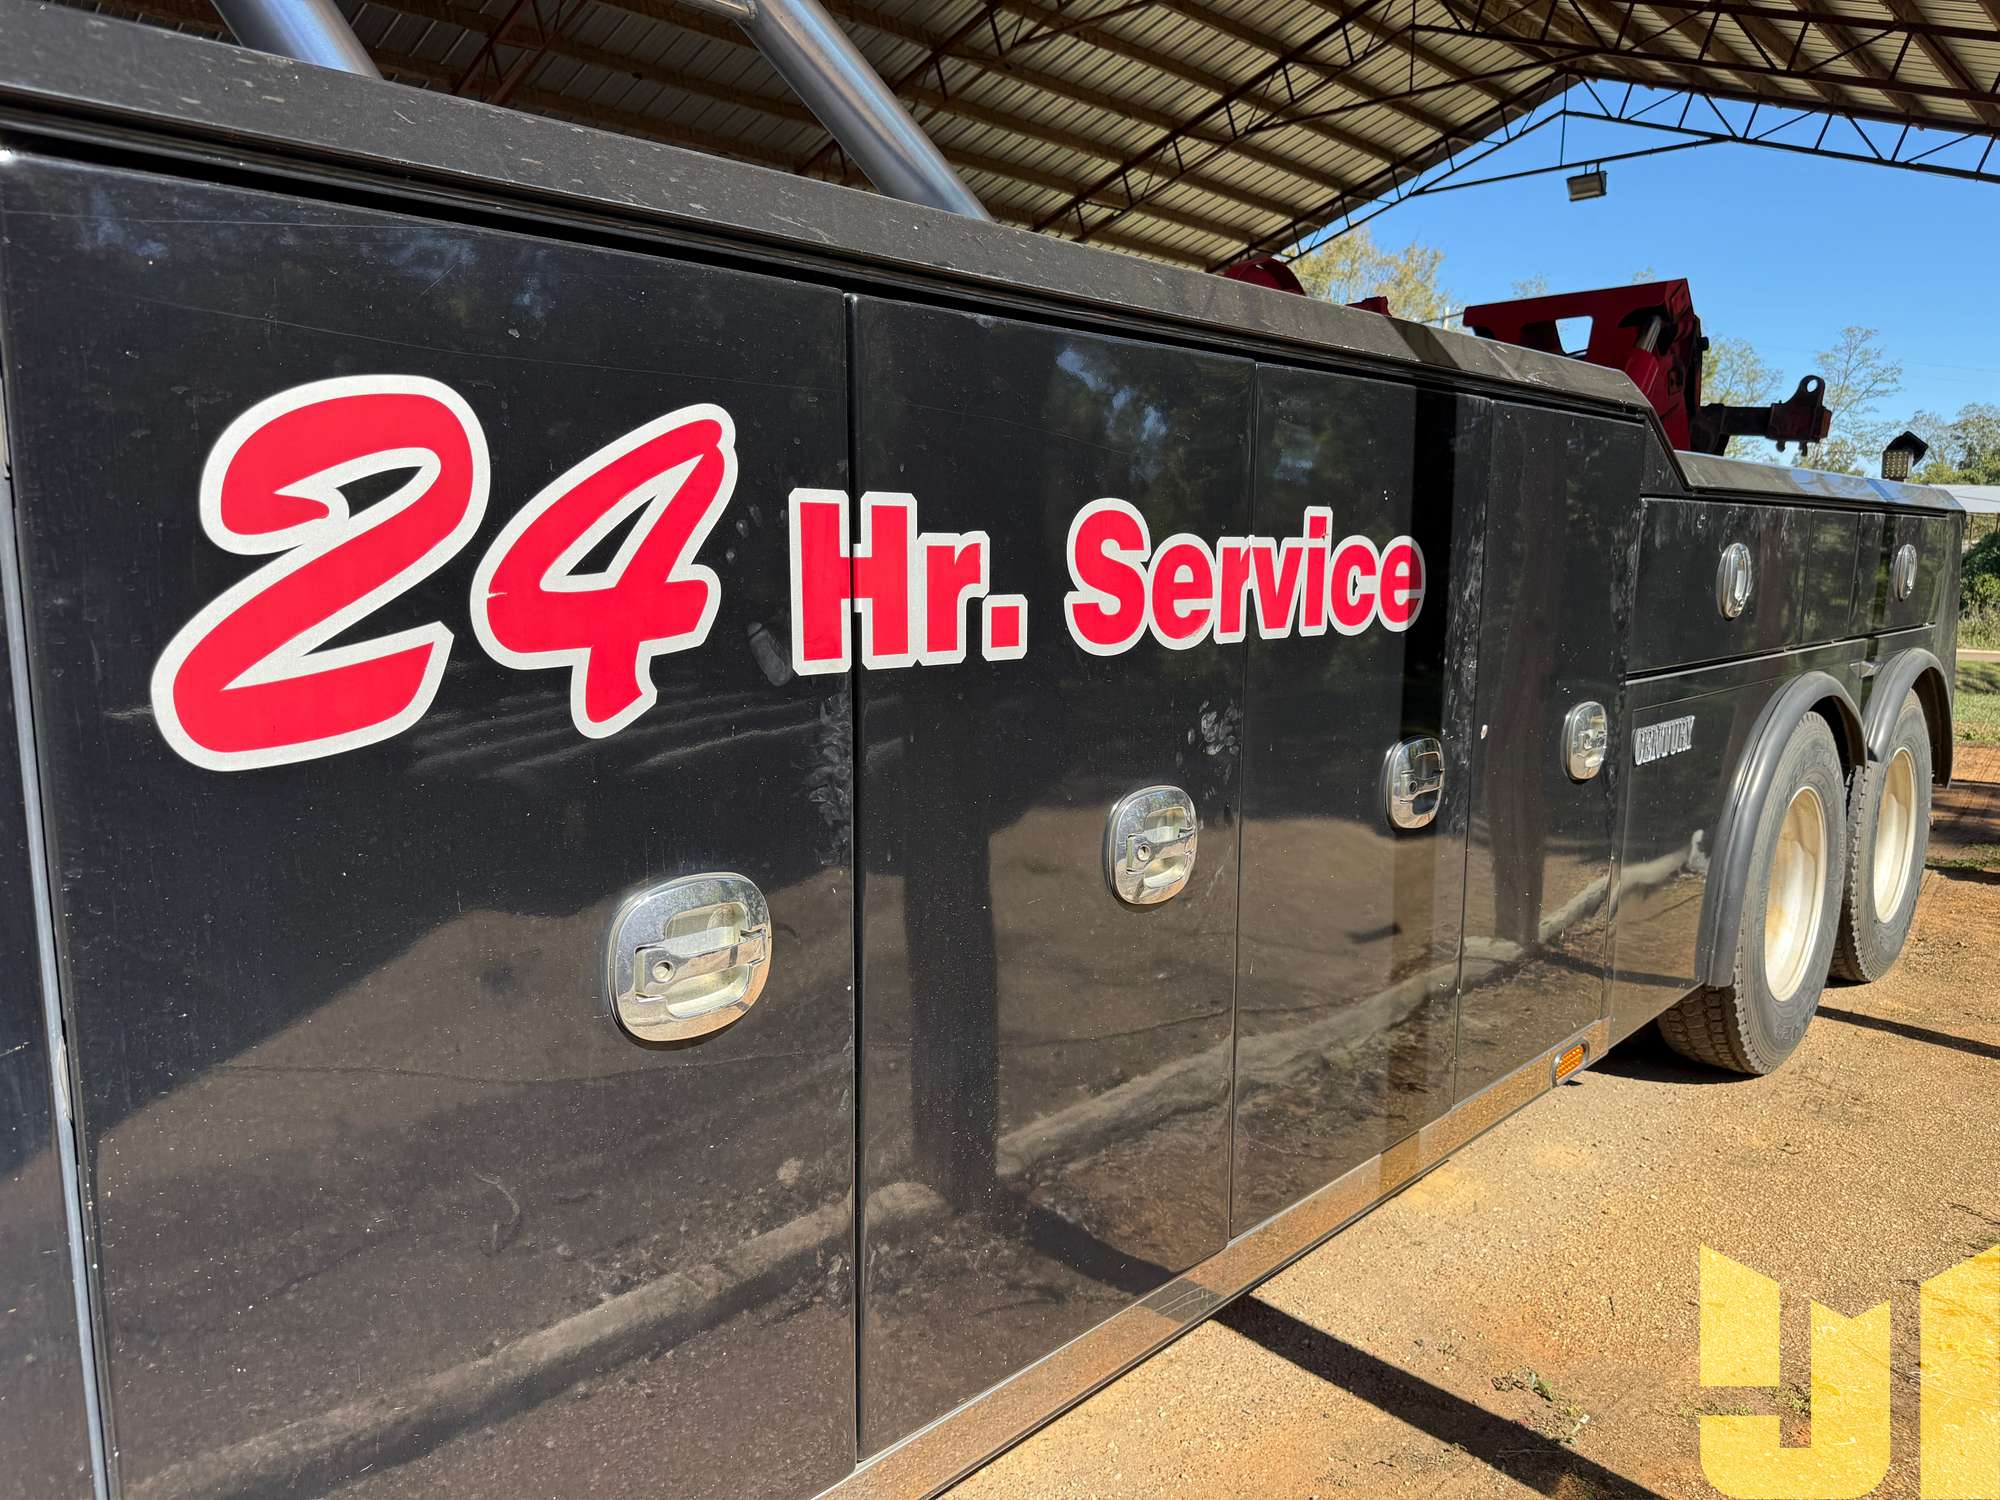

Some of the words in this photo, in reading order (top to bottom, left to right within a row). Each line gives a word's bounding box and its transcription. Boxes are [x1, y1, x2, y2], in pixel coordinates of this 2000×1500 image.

[151, 374, 738, 771] 24
[789, 488, 1028, 676] Hr.
[1064, 498, 1426, 656] Service
[1633, 715, 1696, 766] CENTURY
